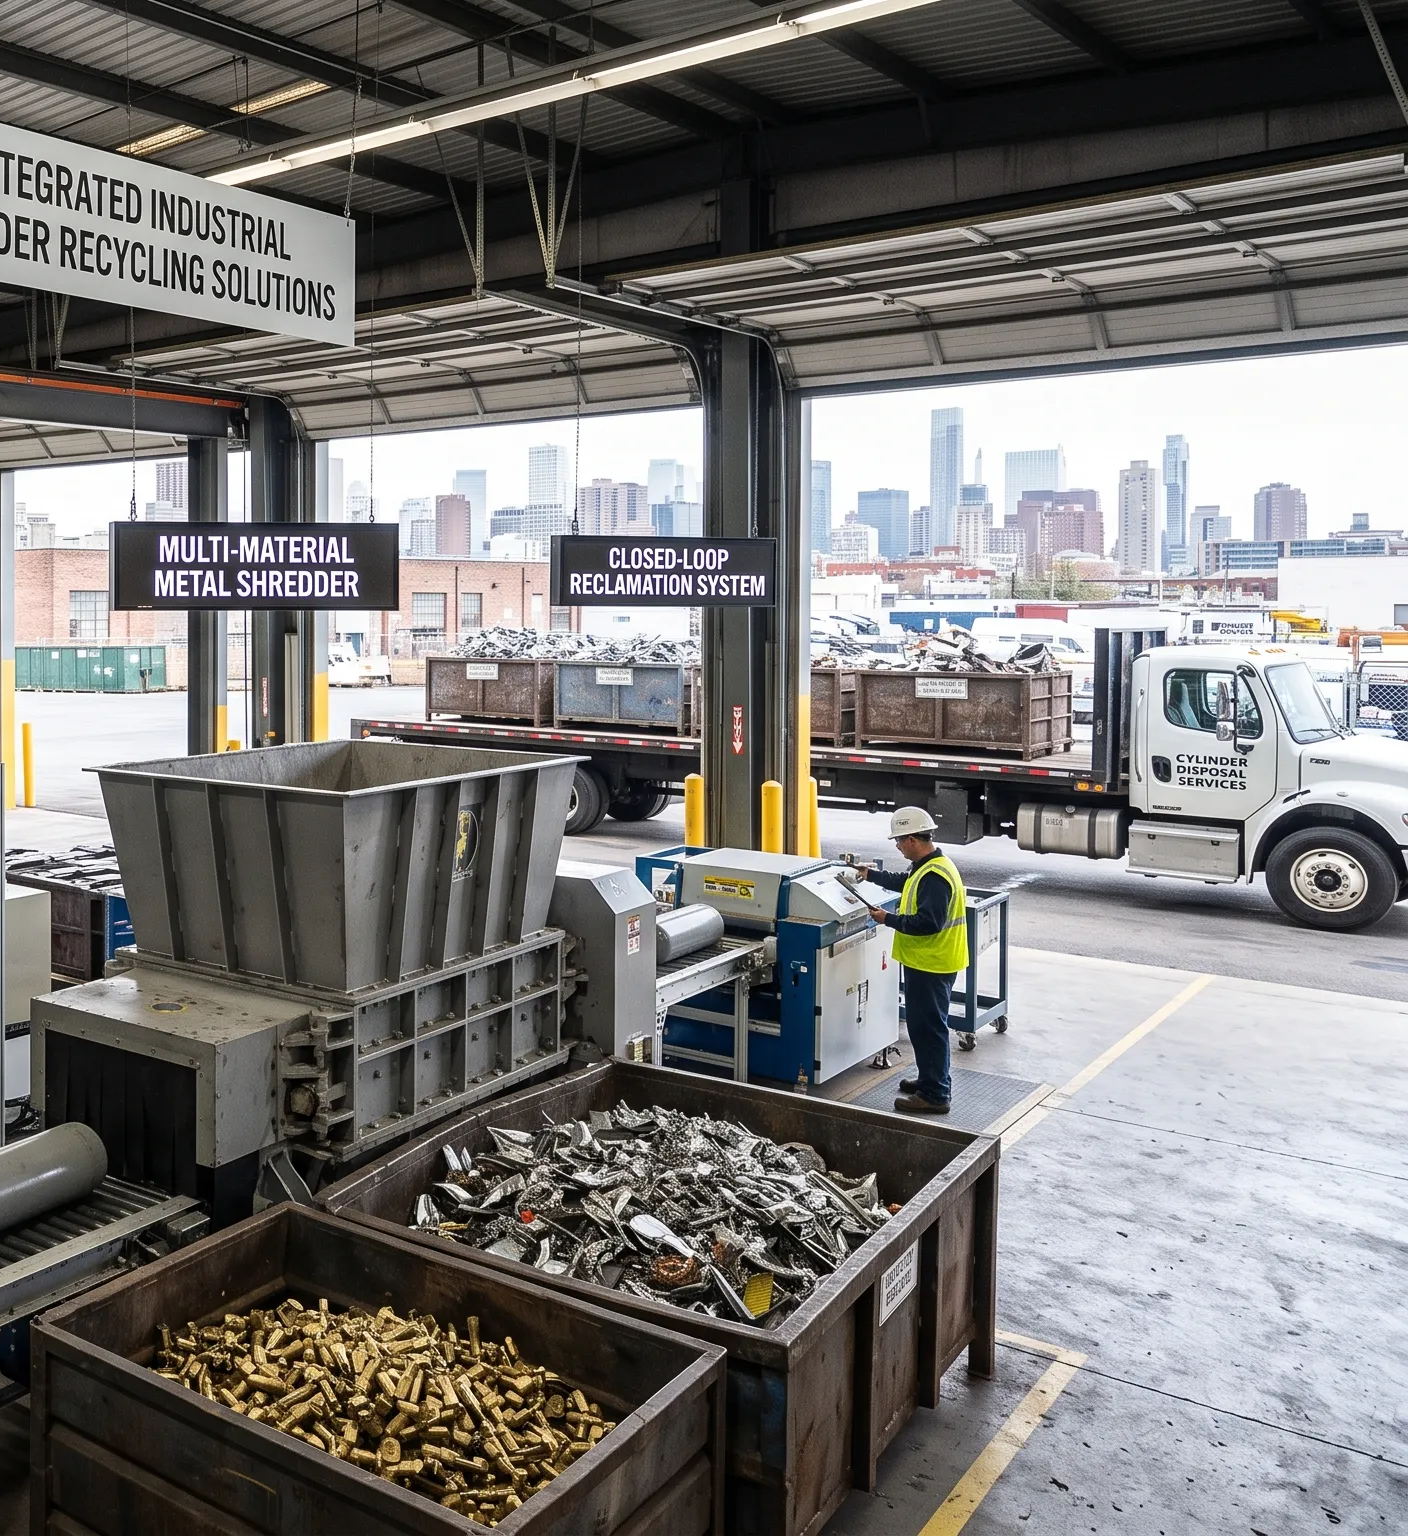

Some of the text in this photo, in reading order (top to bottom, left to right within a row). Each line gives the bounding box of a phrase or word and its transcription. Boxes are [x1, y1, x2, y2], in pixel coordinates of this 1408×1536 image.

[150, 188, 291, 261] INDUSTRIAL
[60, 225, 205, 296] RECYCLING
[211, 259, 336, 321] SOLUTIONS
[159, 535, 355, 564] MULTI-MATERIAL
[609, 547, 729, 570] CLOSED-LOOP
[154, 569, 360, 598] METAL SHREDDER
[570, 573, 766, 597] RECLAMATION SYSTEM
[1175, 753, 1249, 768] CYLINDER
[1176, 765, 1247, 779] DISPOSAL
[1178, 776, 1247, 791] SERVICES
